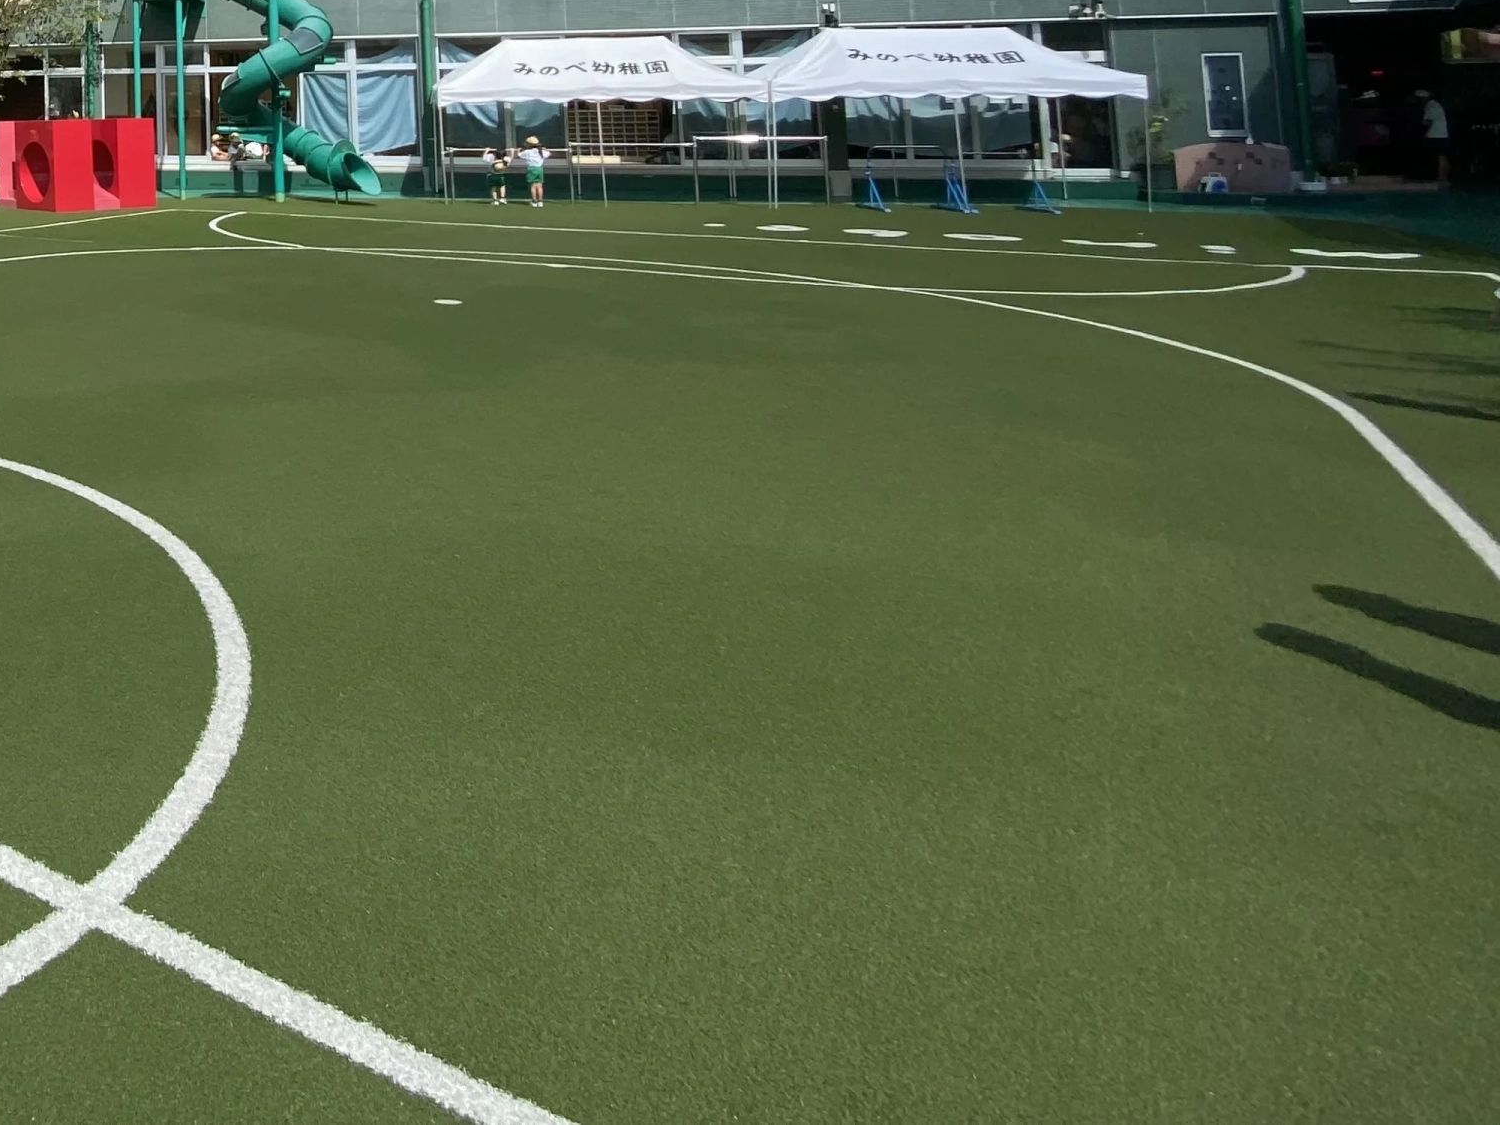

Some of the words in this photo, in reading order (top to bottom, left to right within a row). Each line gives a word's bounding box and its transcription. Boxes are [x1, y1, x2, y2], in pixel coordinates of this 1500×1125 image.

[846, 49, 1026, 65] みのべ幼稚園
[512, 60, 670, 76] みのべ幼稚園
